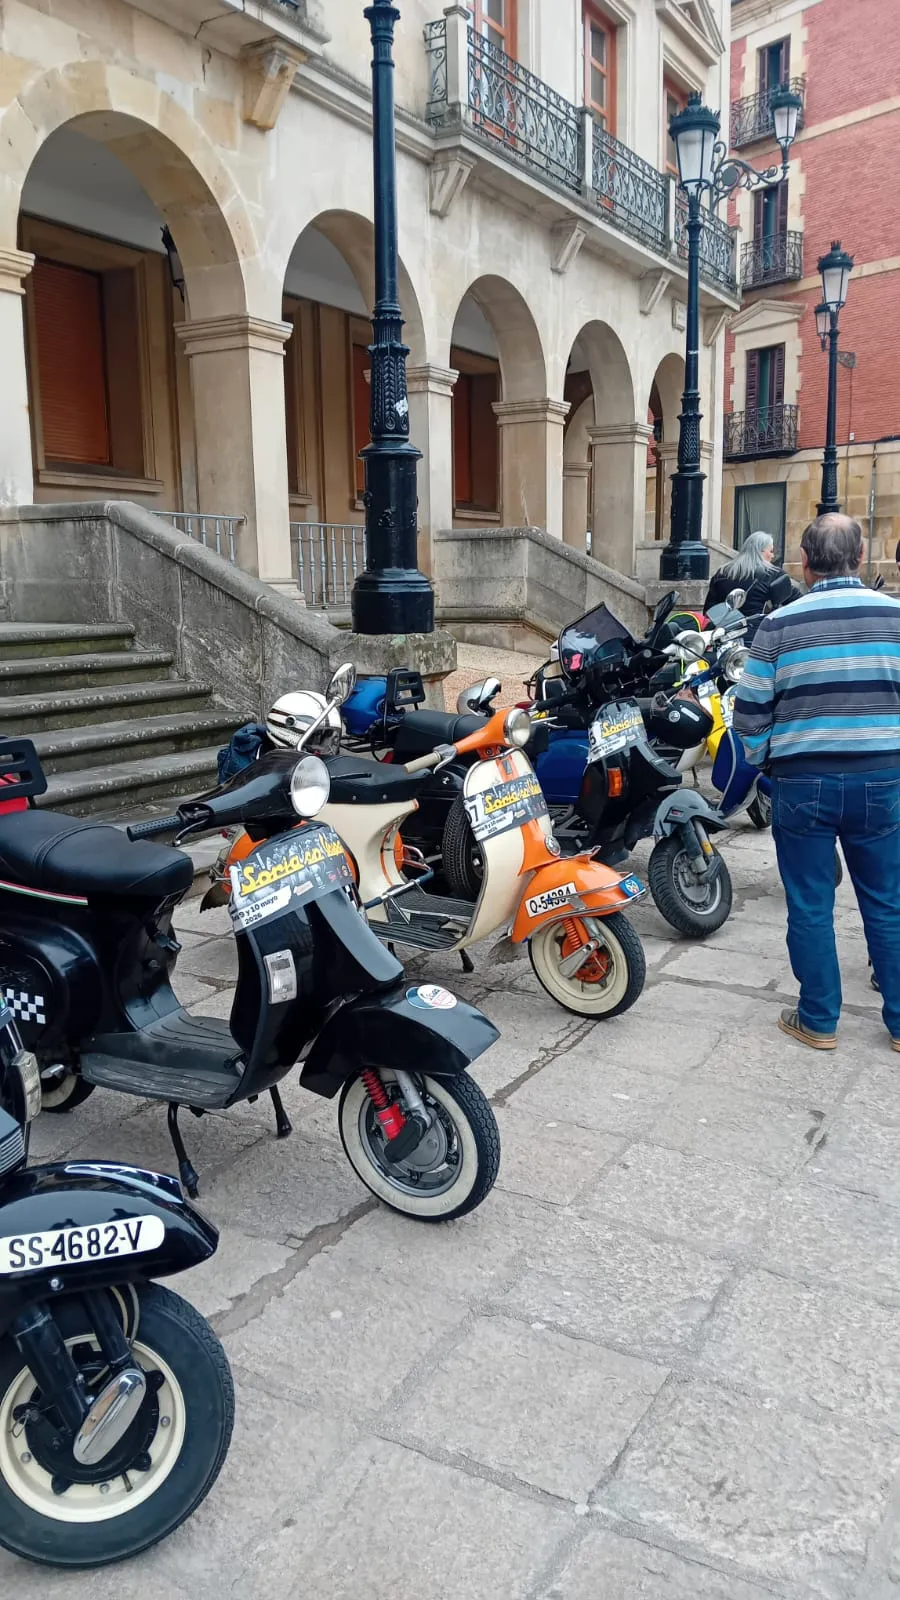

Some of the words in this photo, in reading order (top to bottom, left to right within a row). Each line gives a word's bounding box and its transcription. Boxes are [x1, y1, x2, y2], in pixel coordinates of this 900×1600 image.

[601, 719, 631, 738] Soria
[484, 792, 520, 815] Soria
[240, 856, 305, 897] Soria
[303, 848, 325, 867] en
[250, 903, 260, 913] 10
[260, 896, 279, 908] mayo
[245, 913, 263, 925] 2026
[9, 1220, 143, 1268] SS-4682-V
